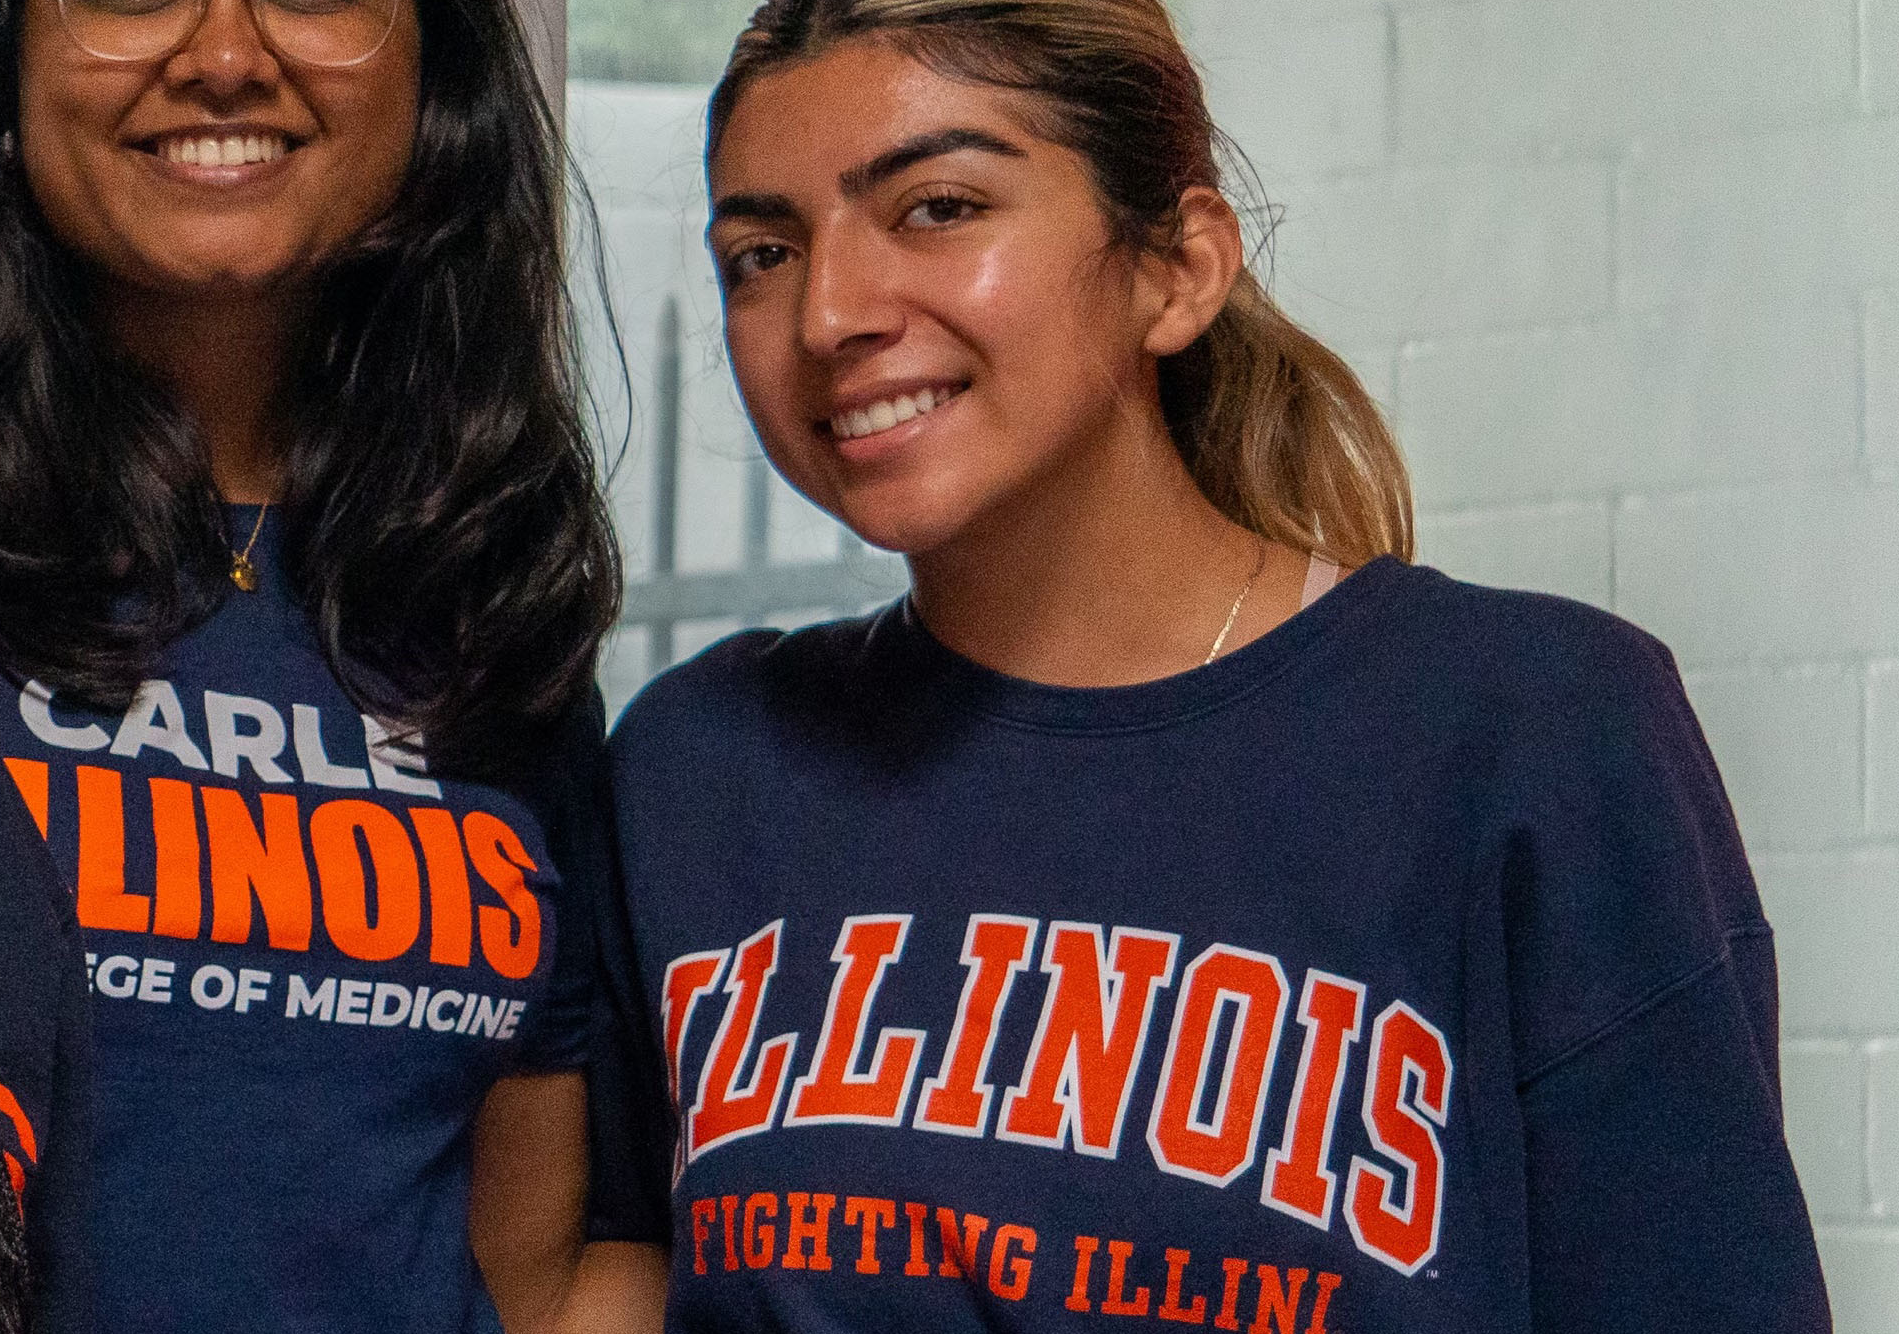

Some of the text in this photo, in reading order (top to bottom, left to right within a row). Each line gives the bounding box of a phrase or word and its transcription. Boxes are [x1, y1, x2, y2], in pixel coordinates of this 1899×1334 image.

[18, 678, 443, 799] CARLE
[4, 757, 542, 979] LINOIS
[189, 964, 271, 1013] OF
[284, 973, 527, 1040] MEDICINE
[660, 912, 1452, 1278] ILLINOIS
[691, 1191, 1037, 1302] FIGHTING
